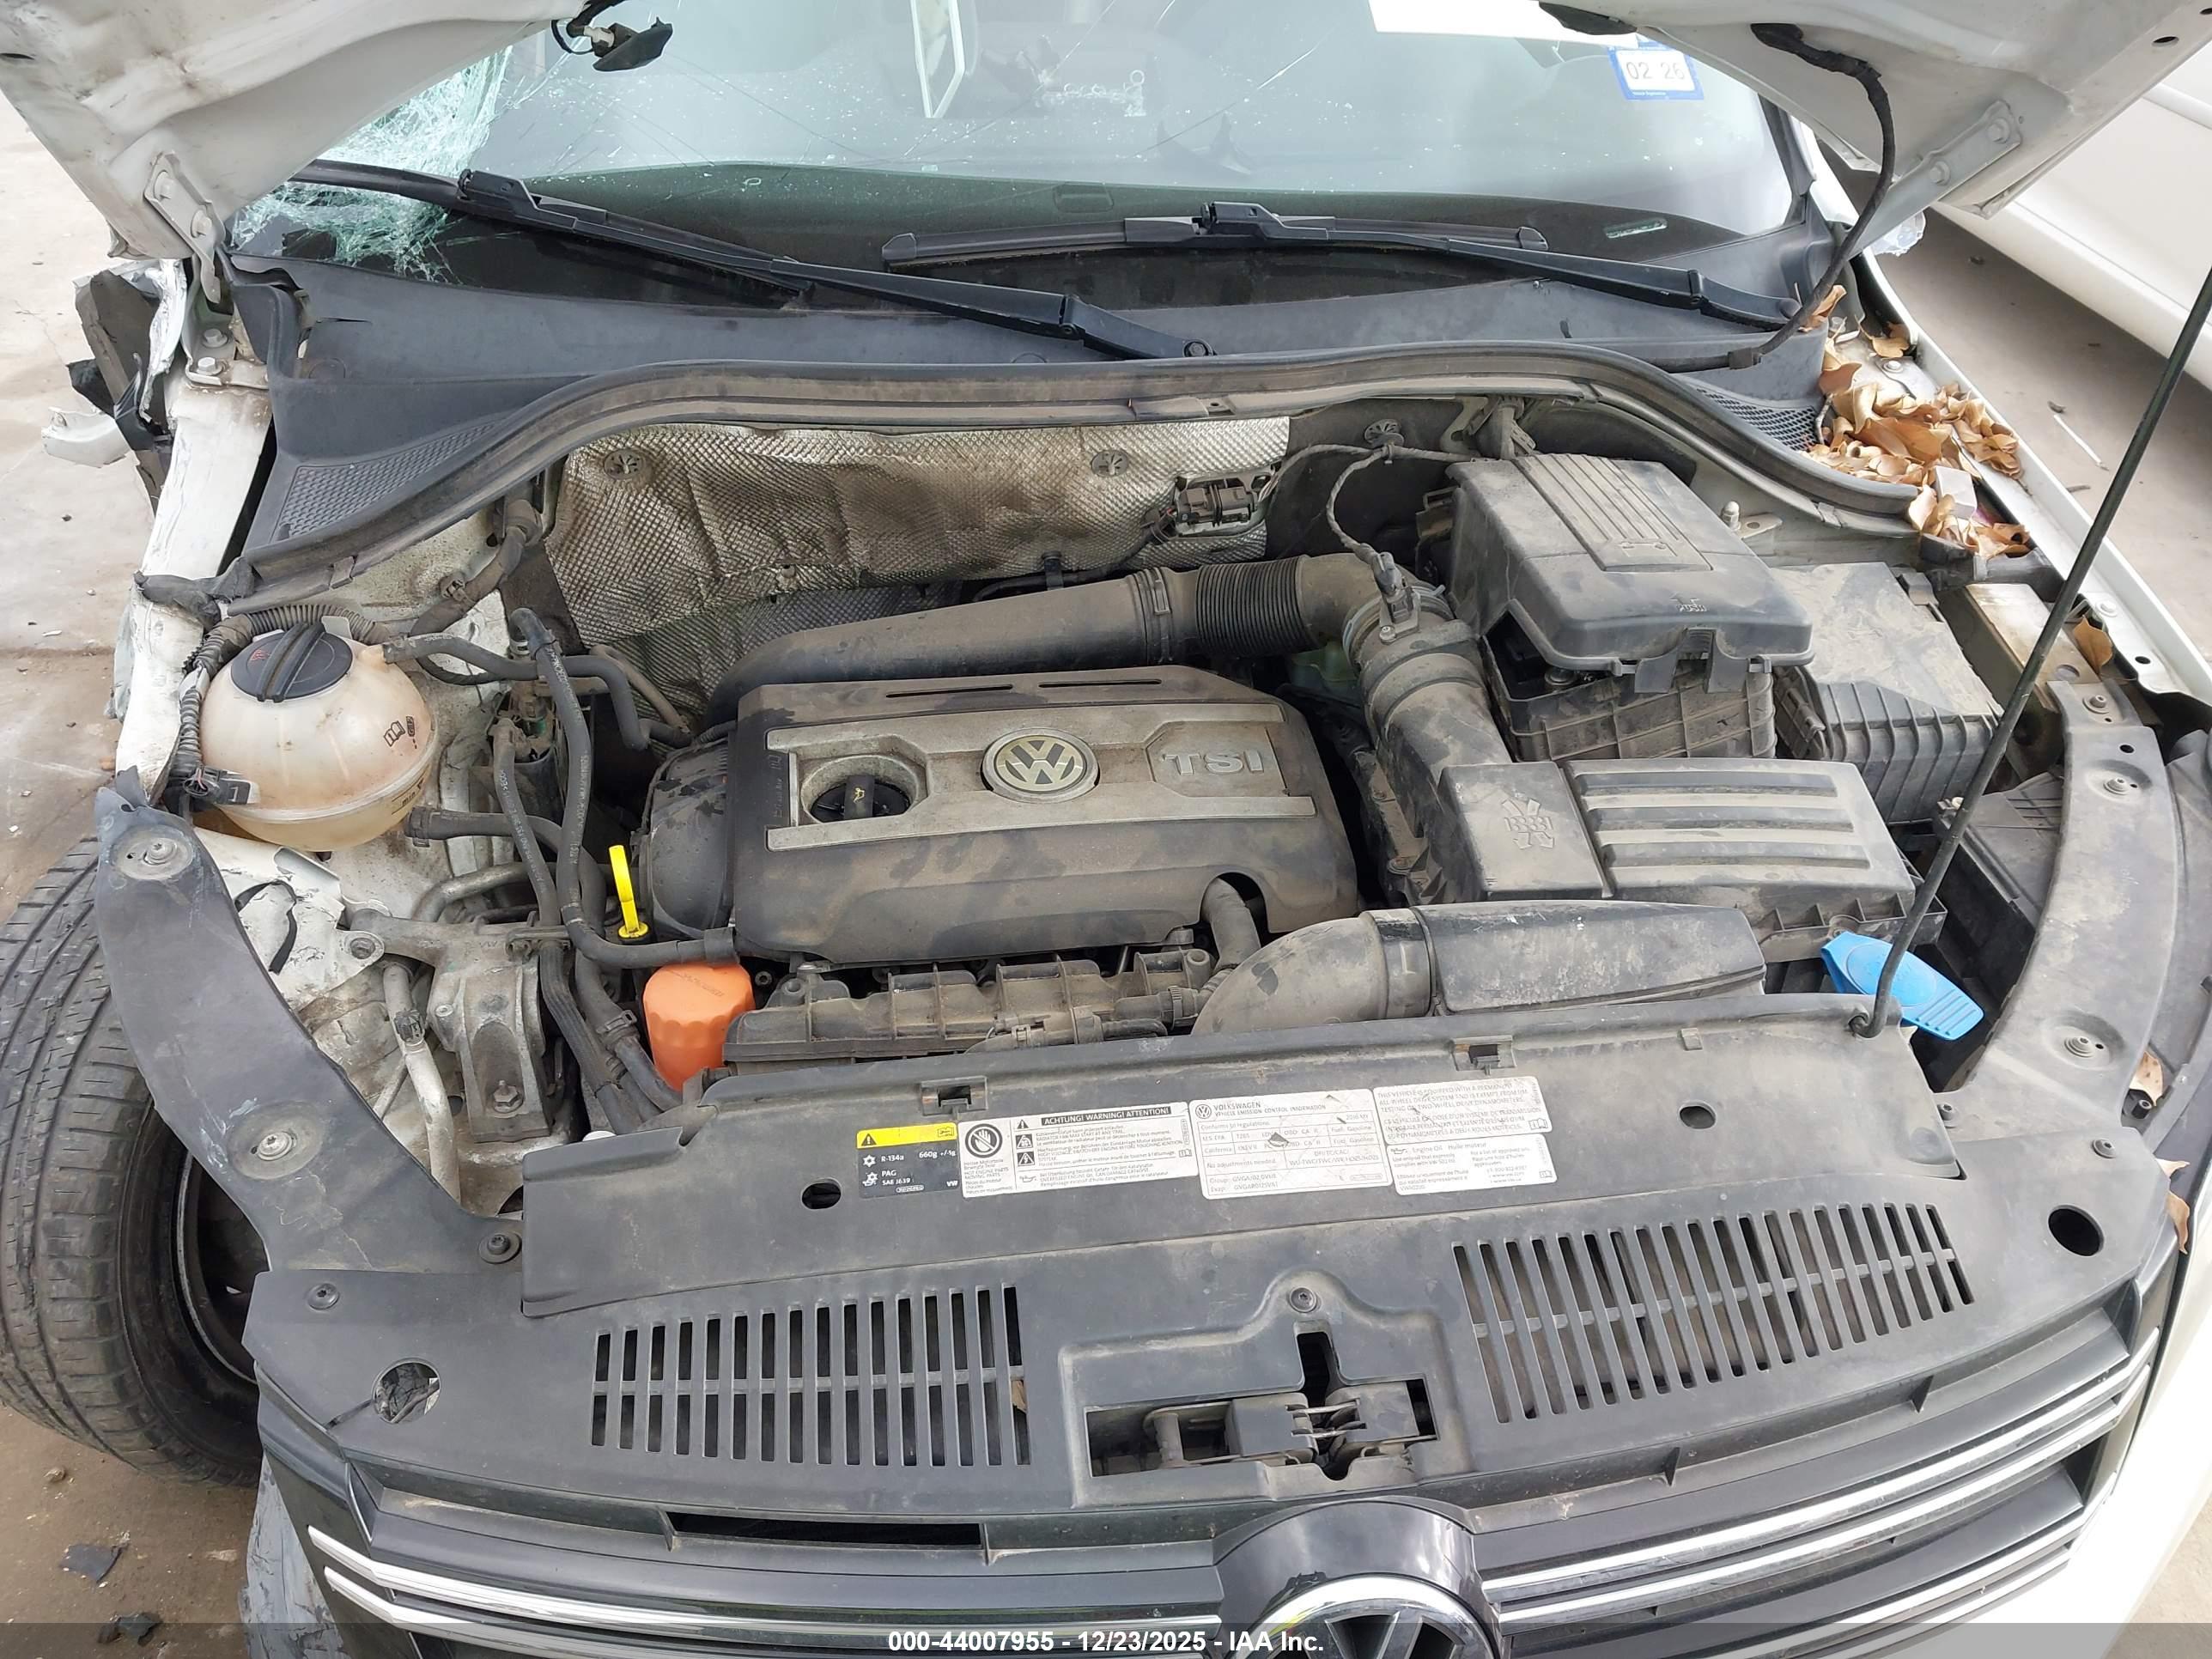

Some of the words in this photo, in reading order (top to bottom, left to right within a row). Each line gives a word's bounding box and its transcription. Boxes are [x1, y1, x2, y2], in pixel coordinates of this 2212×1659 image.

[1626, 61, 1653, 80] 02
[1162, 748, 1265, 776] TSI
[1213, 1102, 1261, 1110] VOLKSWAGEN
[1044, 1115, 1084, 1125] ACHTUNG!
[1085, 1111, 1124, 1121] WARNING!
[1126, 1108, 1169, 1117] ATTENTION!
[919, 1151, 939, 1159] 660g
